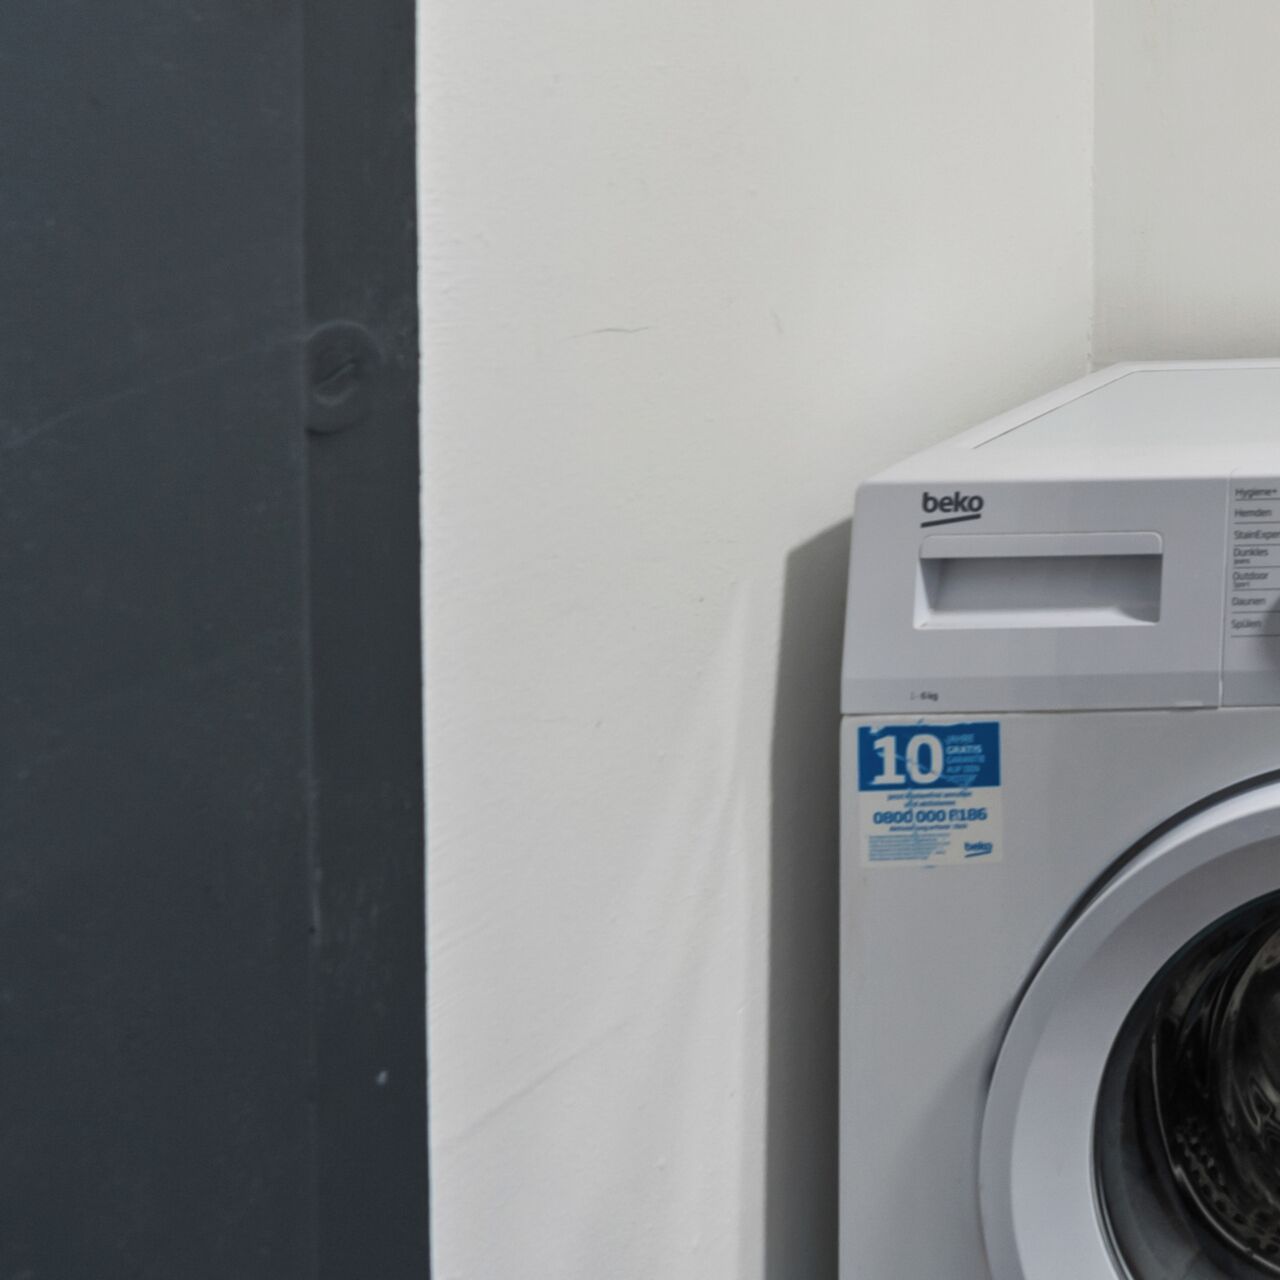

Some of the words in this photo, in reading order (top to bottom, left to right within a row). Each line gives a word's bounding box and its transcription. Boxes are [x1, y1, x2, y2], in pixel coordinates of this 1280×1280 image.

[921, 491, 984, 513] beko
[1235, 509, 1272, 517] Hemden
[1233, 547, 1269, 557] Dunkles
[1232, 571, 1269, 581] Outdoor
[1232, 597, 1267, 606] Daunen
[1231, 619, 1263, 630] Spülen
[873, 733, 944, 785] 10
[873, 810, 913, 824] 0800
[915, 809, 947, 823] 000
